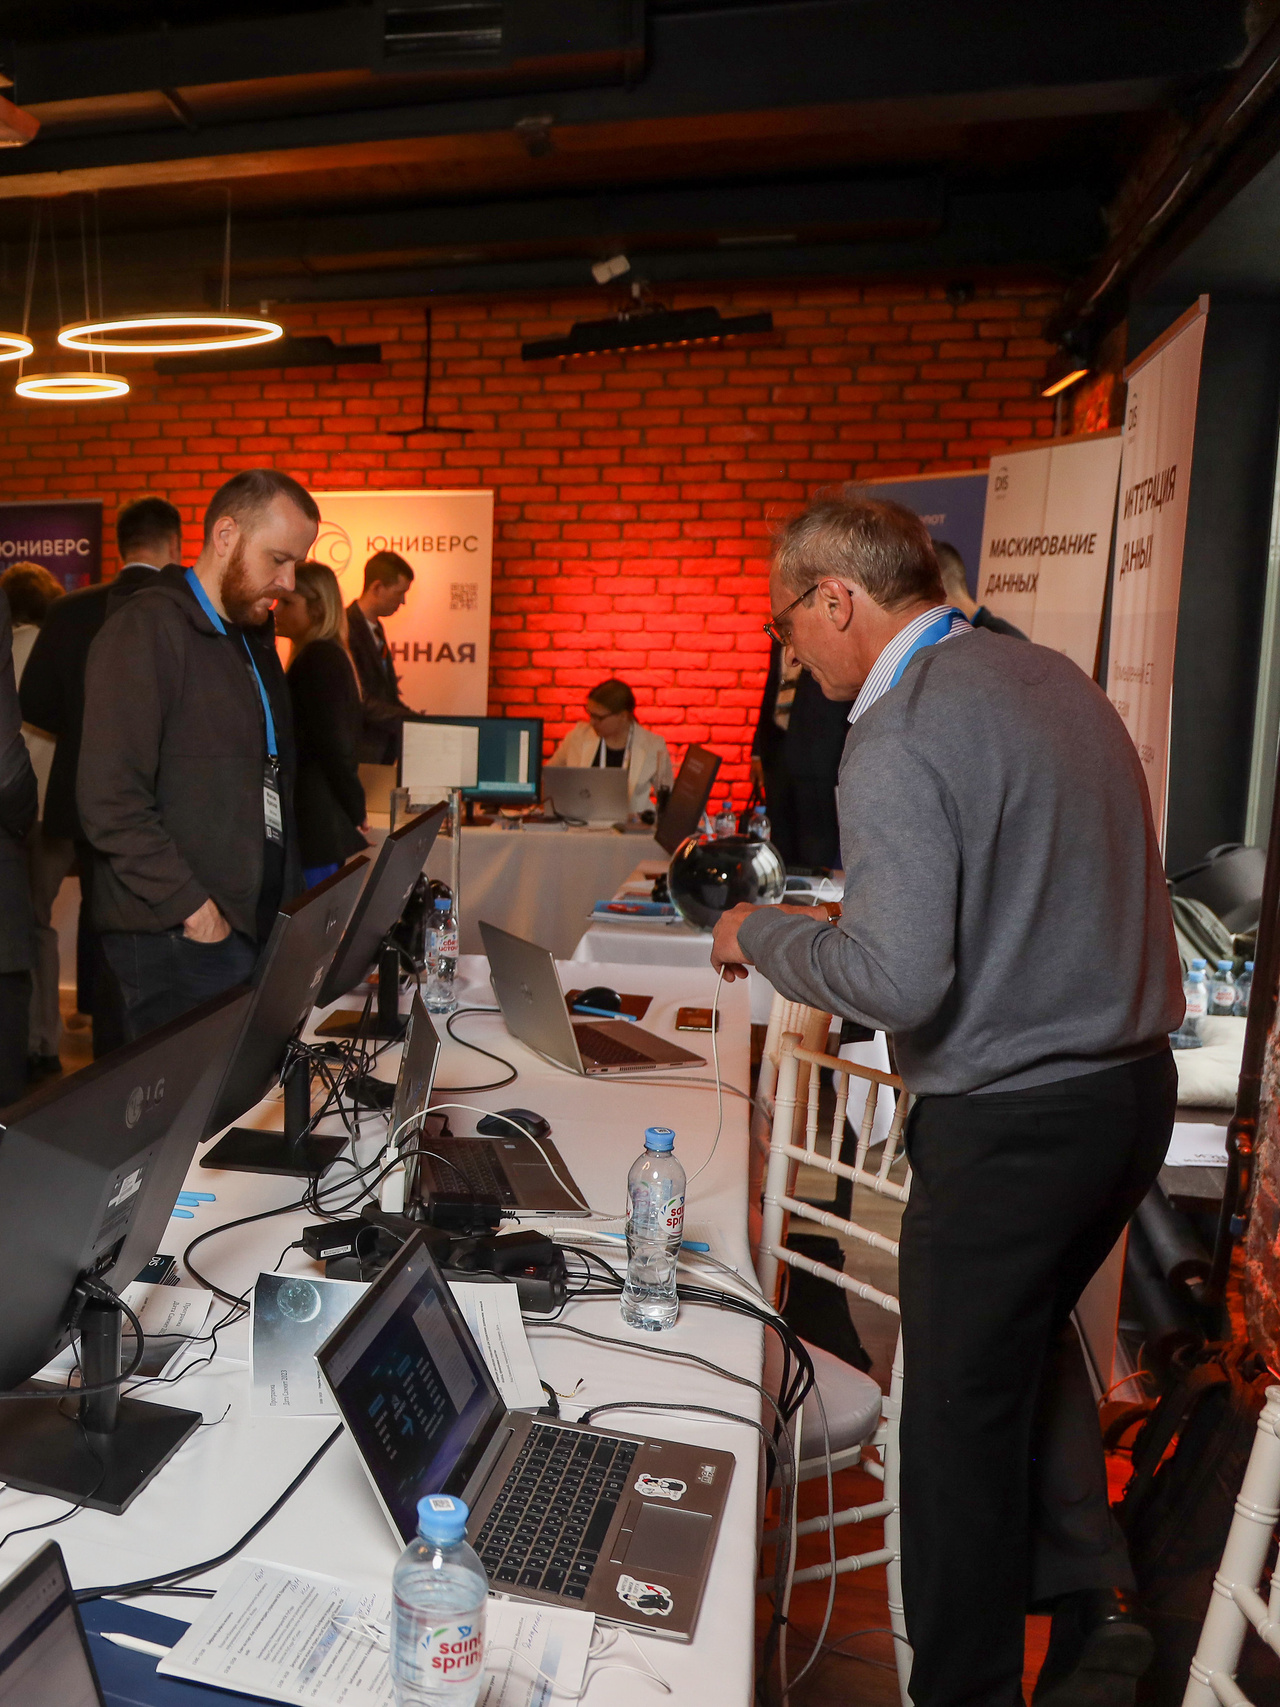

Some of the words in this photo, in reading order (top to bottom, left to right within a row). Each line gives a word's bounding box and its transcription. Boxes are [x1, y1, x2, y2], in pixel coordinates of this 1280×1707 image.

[995, 475, 1009, 491] DIS
[1123, 464, 1177, 520] ИНТЕГРАЦИЯ
[366, 535, 478, 553] ЮНИВЕРС
[989, 533, 1097, 558] МАСКИРОВАНИЕ
[985, 573, 1039, 596] ДАННЫХ
[391, 642, 476, 663] ННАЯ
[671, 1205, 685, 1217] sai
[666, 1215, 685, 1229] spri
